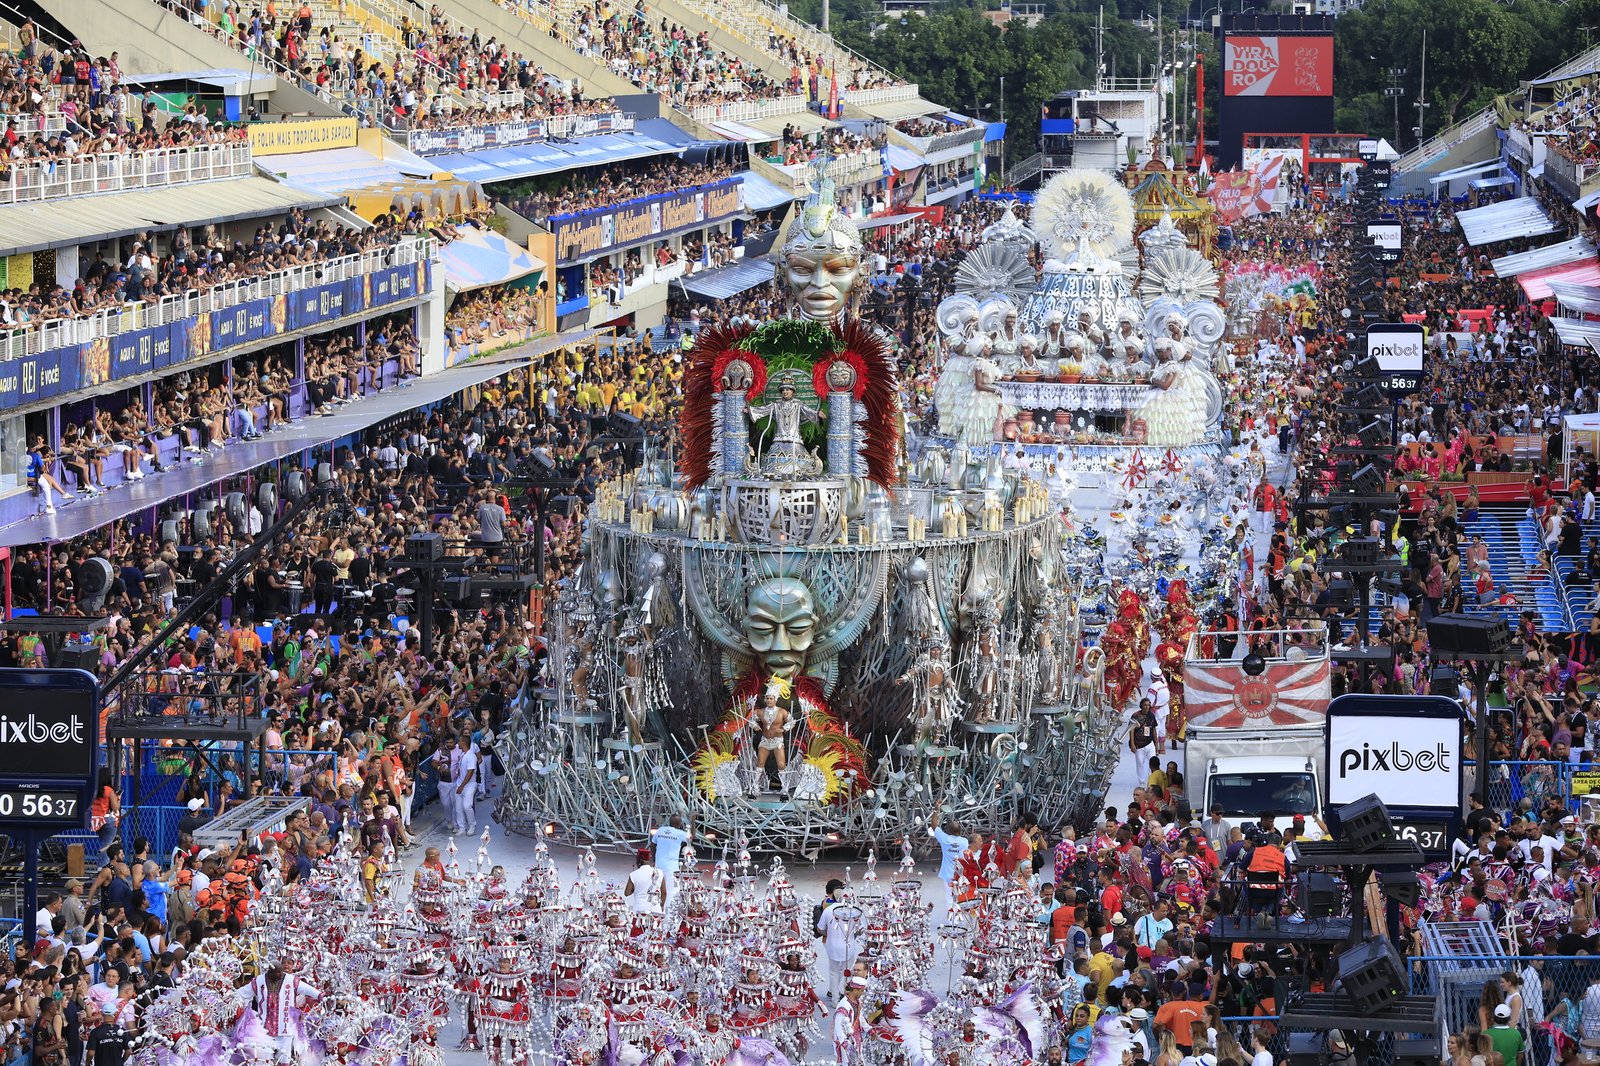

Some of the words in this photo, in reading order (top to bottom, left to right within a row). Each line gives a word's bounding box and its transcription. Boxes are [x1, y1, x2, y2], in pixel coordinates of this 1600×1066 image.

[1232, 46, 1273, 59] VIRA
[1232, 59, 1270, 73] DOU
[1232, 73, 1257, 87] RO
[251, 133, 256, 148] A
[258, 131, 275, 147] FOLIA
[277, 130, 291, 146] MAIS
[293, 128, 320, 145] TROPICAL
[322, 127, 329, 142] DA
[390, 272, 399, 296] REI
[320, 291, 330, 316] REI
[236, 309, 247, 337] REI
[119, 348, 131, 363] AQUI
[131, 346, 135, 359] O
[139, 335, 151, 366] REI
[13, 376, 18, 389] O
[22, 360, 36, 395] REI
[40, 370, 45, 387] É
[45, 367, 60, 384] VOCÊ!
[1391, 378, 1406, 389] 56
[1406, 380, 1417, 389] 37
[0, 713, 84, 744] ixbet
[1340, 741, 1450, 779] pixbet
[0, 793, 14, 816] 0
[22, 794, 53, 816] 56
[55, 800, 77, 816] 37
[1420, 831, 1443, 848] 37
[283, 989, 291, 1035] HARMONIA
